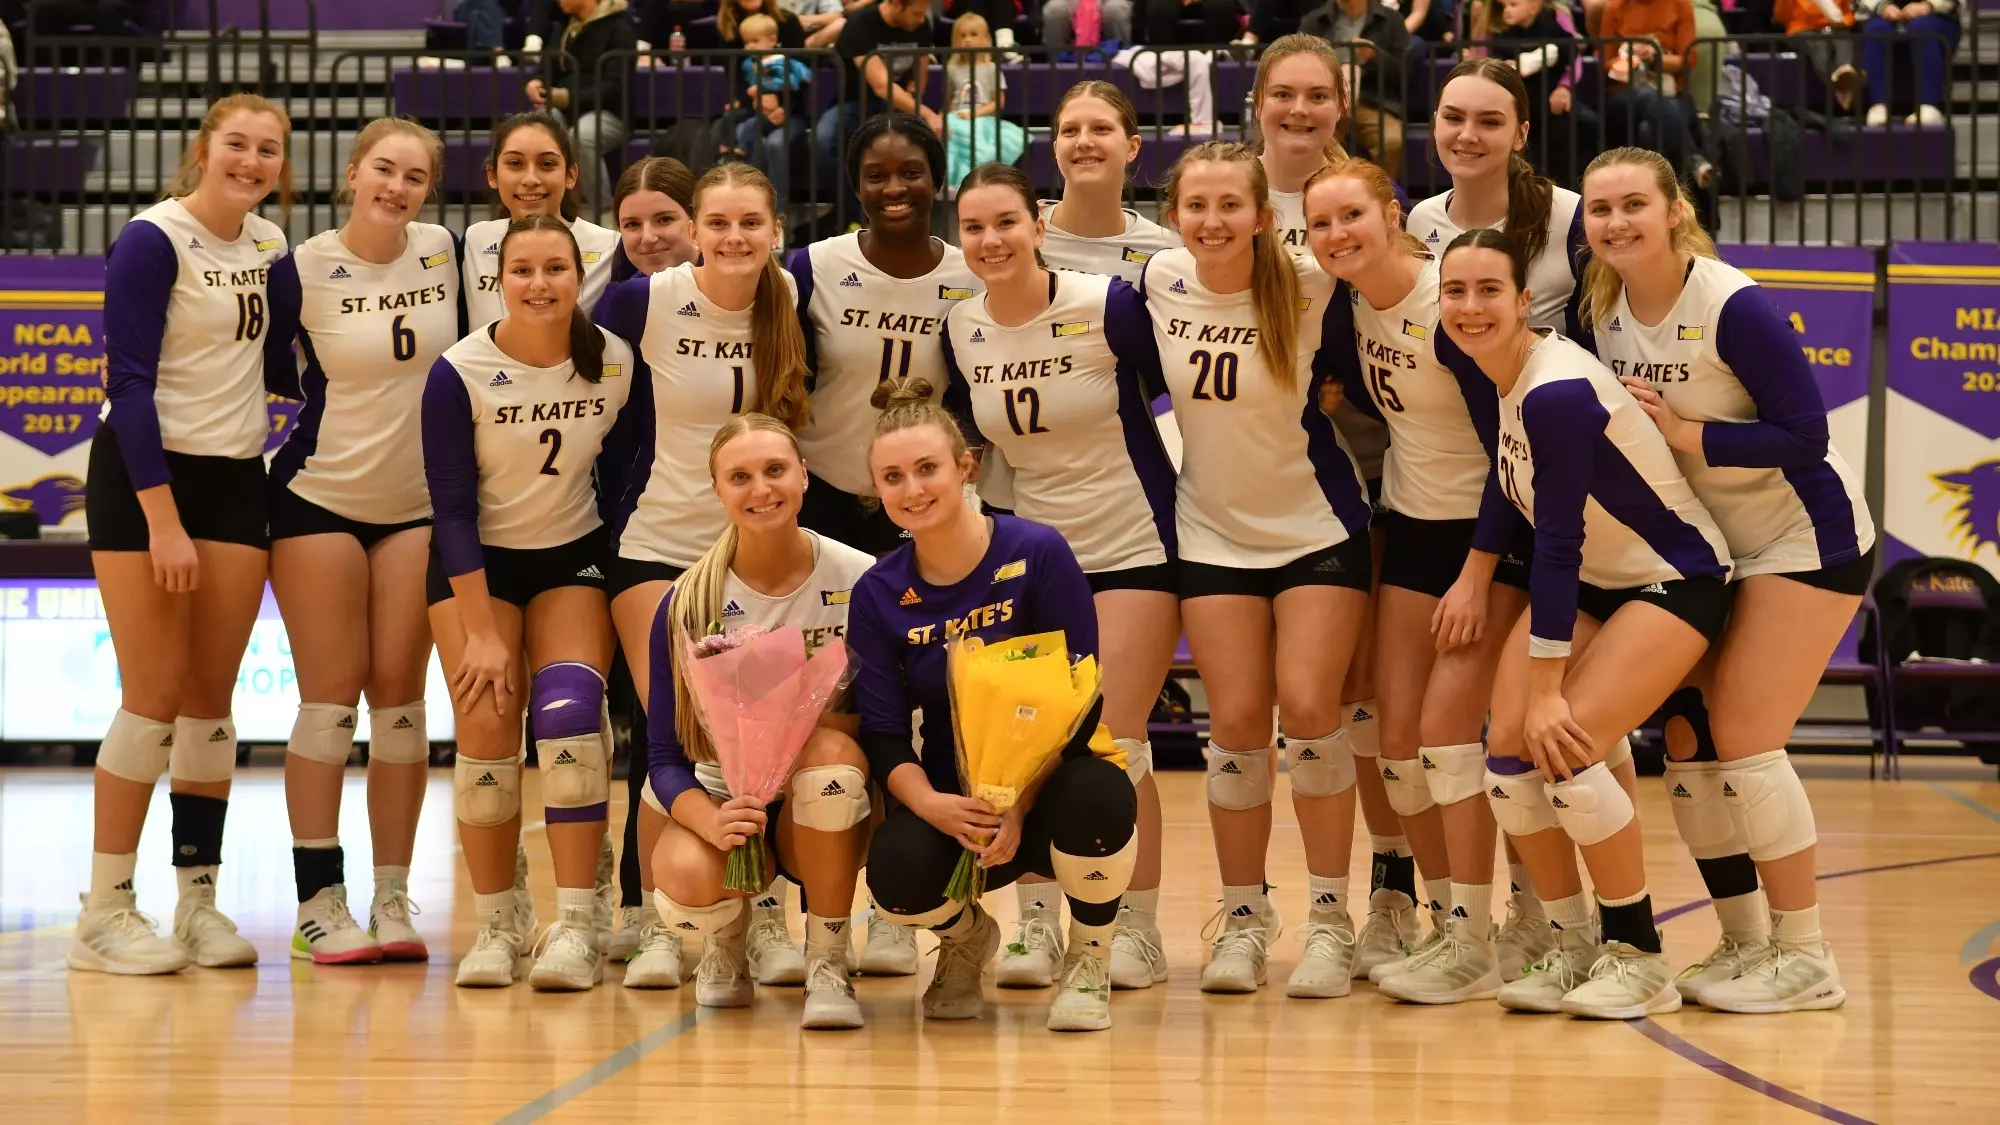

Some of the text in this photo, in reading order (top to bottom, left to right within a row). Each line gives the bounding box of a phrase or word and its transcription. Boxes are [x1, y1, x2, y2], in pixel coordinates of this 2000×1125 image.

[204, 271, 226, 287] ST.
[341, 283, 445, 314] ST. KATE'S
[235, 292, 264, 341] 18
[840, 308, 943, 336] ST. KATE'
[1167, 318, 1192, 339] ST.
[1955, 307, 2000, 331] MI
[14, 323, 93, 346] NCAA
[392, 314, 416, 361] 6
[676, 338, 707, 358] ST.
[880, 337, 912, 381] 11
[1366, 338, 1417, 370] KATE'S
[1910, 337, 2000, 367] Cham
[973, 355, 1072, 384] ST. KATE'S
[1189, 349, 1239, 402] 20
[1632, 362, 1689, 383] KATE'S
[731, 366, 744, 414] 1
[1368, 362, 1405, 412] 15
[23, 413, 82, 433] 2017
[495, 398, 606, 424] ST. KATE'S
[1003, 387, 1050, 436] 12
[539, 428, 562, 476] 2
[907, 623, 938, 645] ST.
[820, 787, 846, 797] adidas
